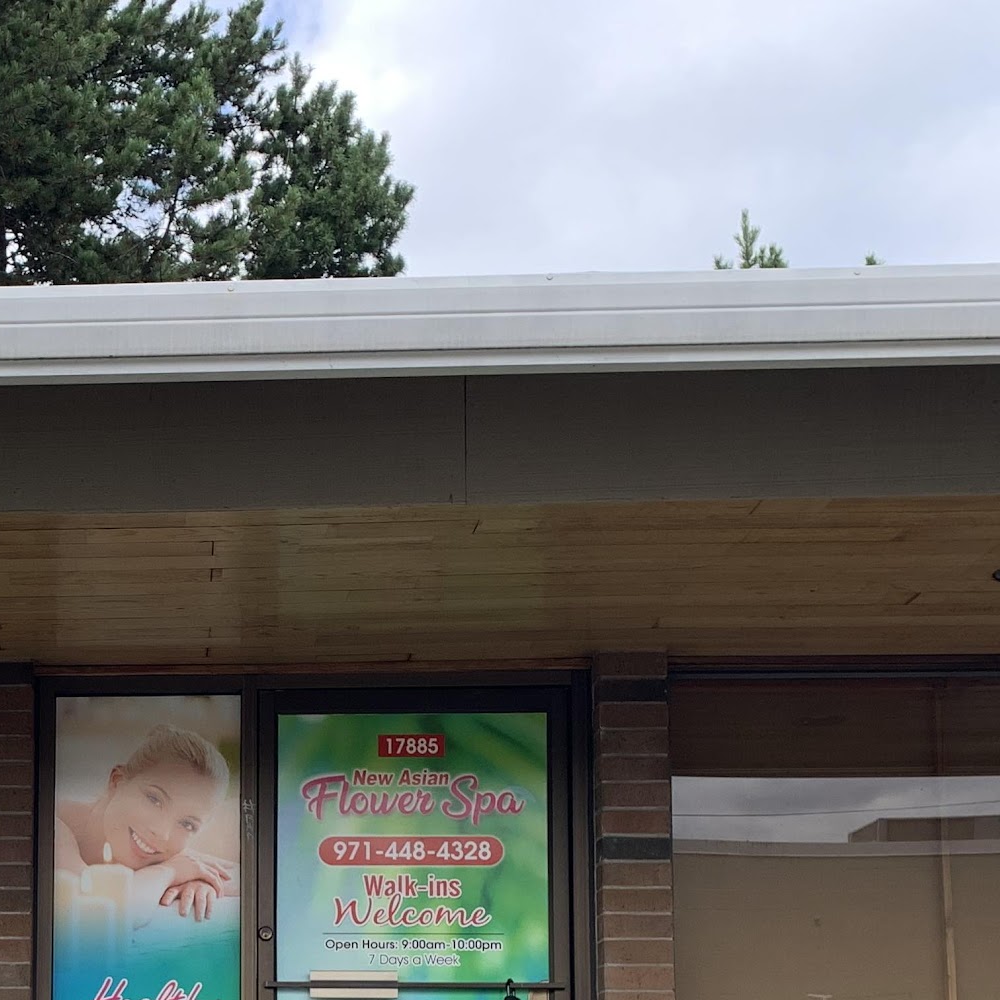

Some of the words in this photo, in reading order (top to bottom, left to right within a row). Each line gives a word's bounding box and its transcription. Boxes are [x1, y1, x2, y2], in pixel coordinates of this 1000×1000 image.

[385, 738, 439, 755] 17885
[353, 769, 393, 787] New
[399, 769, 449, 786] Asian
[301, 774, 435, 821] Flower
[441, 774, 525, 826] Spa
[333, 841, 492, 861] 971-448-4328
[363, 874, 462, 897] Walk-ins
[333, 893, 492, 927] Welcome
[325, 940, 358, 952] Open
[362, 940, 398, 950] Hours:
[402, 940, 502, 952] 9:00am-10:00pm
[369, 955, 375, 965] 7
[380, 955, 409, 967] Days
[413, 957, 421, 965] a
[424, 955, 459, 965] Week
